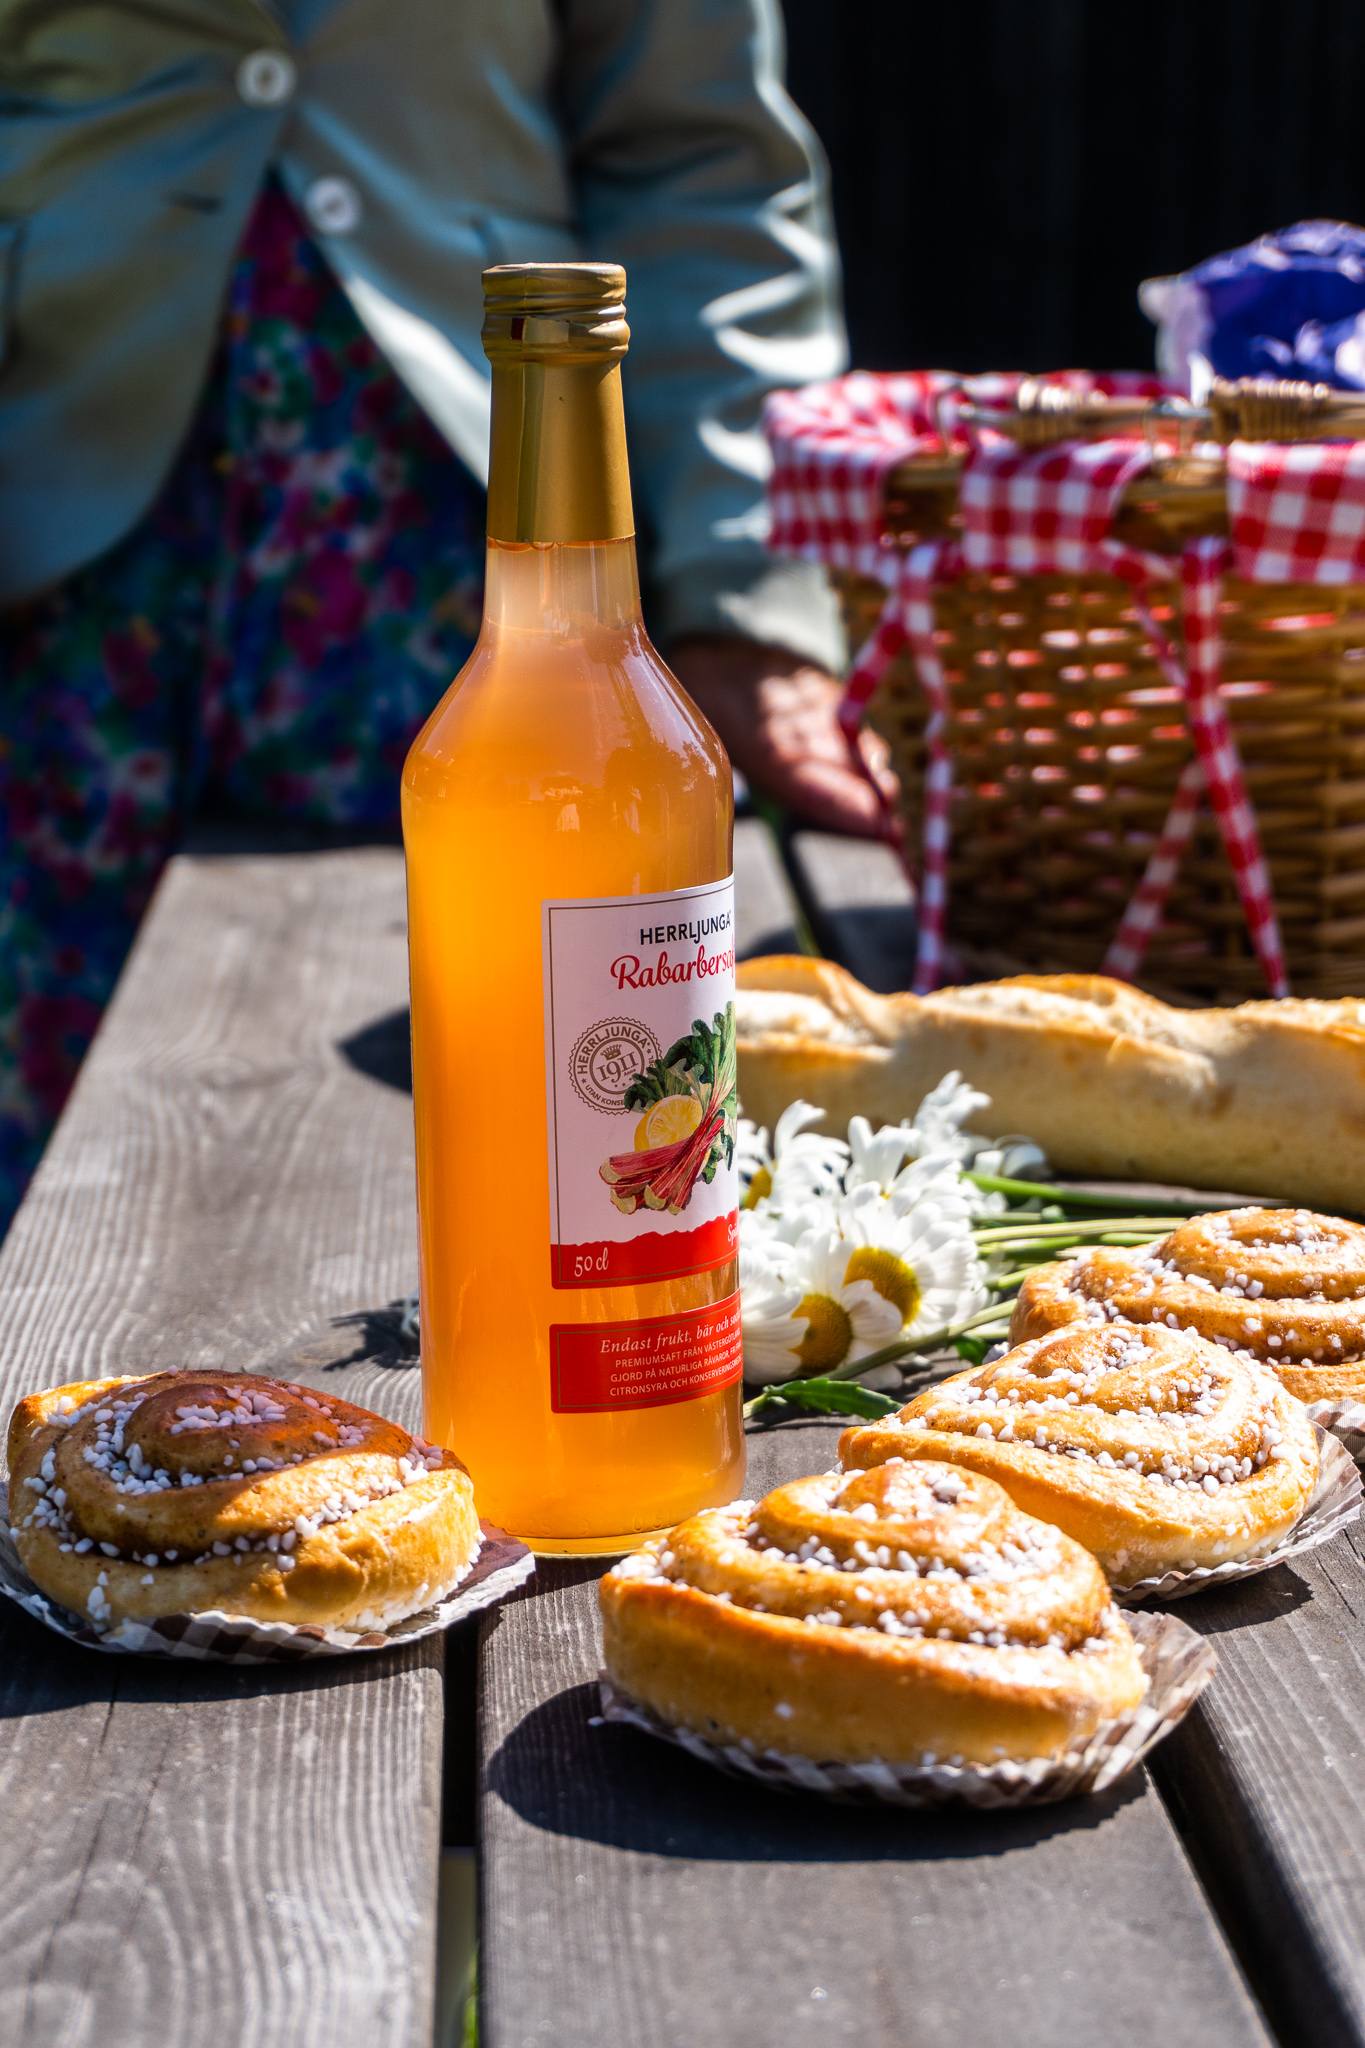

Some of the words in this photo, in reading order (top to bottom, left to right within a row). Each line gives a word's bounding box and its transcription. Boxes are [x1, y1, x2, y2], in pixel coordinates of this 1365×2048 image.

[640, 912, 731, 945] HERRLJUNGA
[577, 1026, 648, 1075] HERRLJUNGA
[596, 1051, 639, 1083] 1911
[585, 1084, 602, 1101] UTAN
[574, 1256, 593, 1278] 50
[596, 1247, 609, 1271] cl
[600, 1337, 652, 1354] Endast
[654, 1329, 693, 1352] frukt,
[696, 1325, 714, 1340] bär
[715, 1315, 730, 1334] och
[610, 1371, 643, 1383] GJORD
[645, 1368, 657, 1379] PÅ
[658, 1359, 703, 1377] NATURLIGA
[615, 1351, 681, 1368] PREMIUMSAFT
[683, 1343, 703, 1360] FRÅN
[610, 1381, 668, 1397] CITRONSYRA
[669, 1378, 688, 1389] OCH
